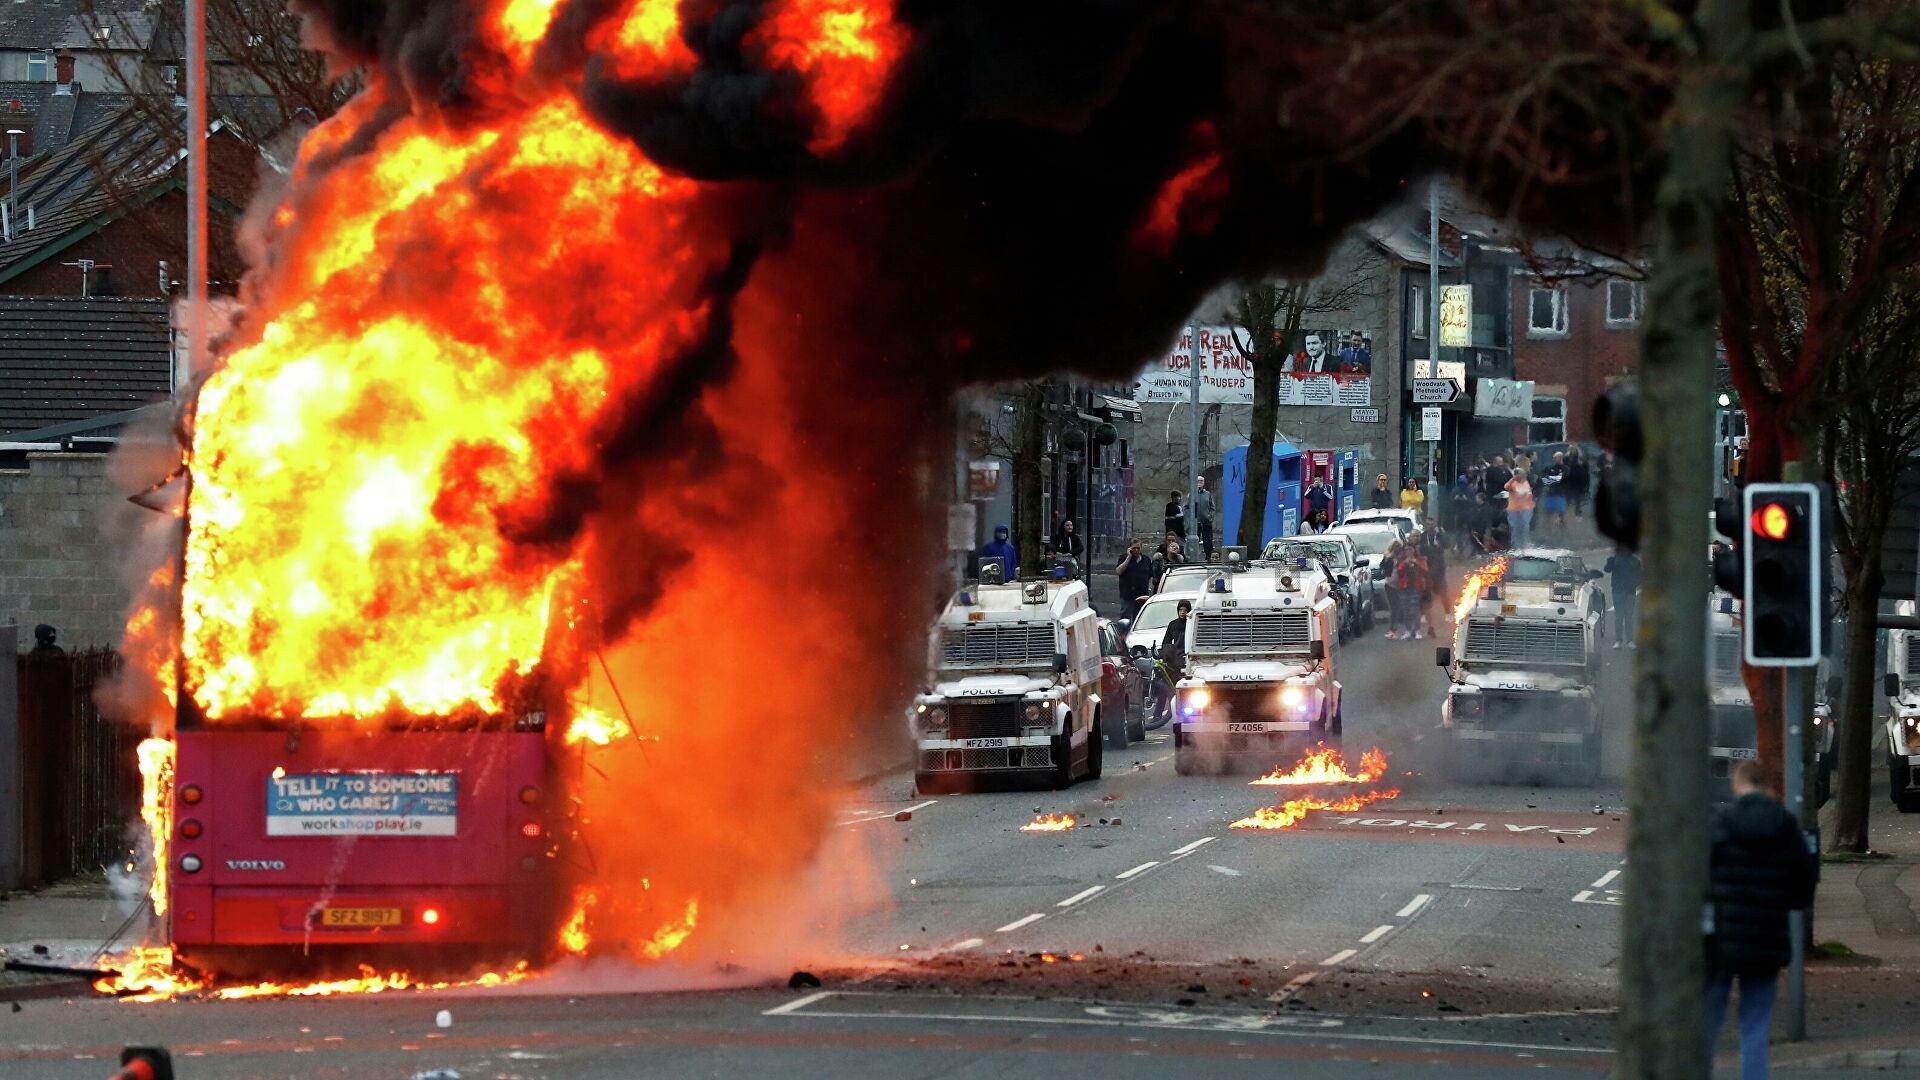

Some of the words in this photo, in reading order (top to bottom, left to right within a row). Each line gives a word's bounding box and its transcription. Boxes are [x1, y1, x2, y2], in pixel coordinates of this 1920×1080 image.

[1199, 330, 1233, 351] REAL
[1213, 351, 1252, 371] FAMIL
[1154, 380, 1177, 388] HUMAN
[1498, 681, 1540, 689] POLICE
[962, 688, 1005, 696] POLICE
[1241, 723, 1263, 732] 4056
[966, 740, 983, 748] MFZ
[984, 738, 1003, 747] 2919
[274, 778, 323, 797] TELL
[325, 778, 340, 791] IT
[345, 780, 366, 793] TO
[369, 778, 453, 794] SOMEONE
[298, 799, 337, 813] WHO
[302, 817, 423, 833] workshopplay.ie
[1330, 817, 1599, 835] PATROL
[226, 860, 286, 870] VOLVO
[331, 910, 358, 923] SFZ
